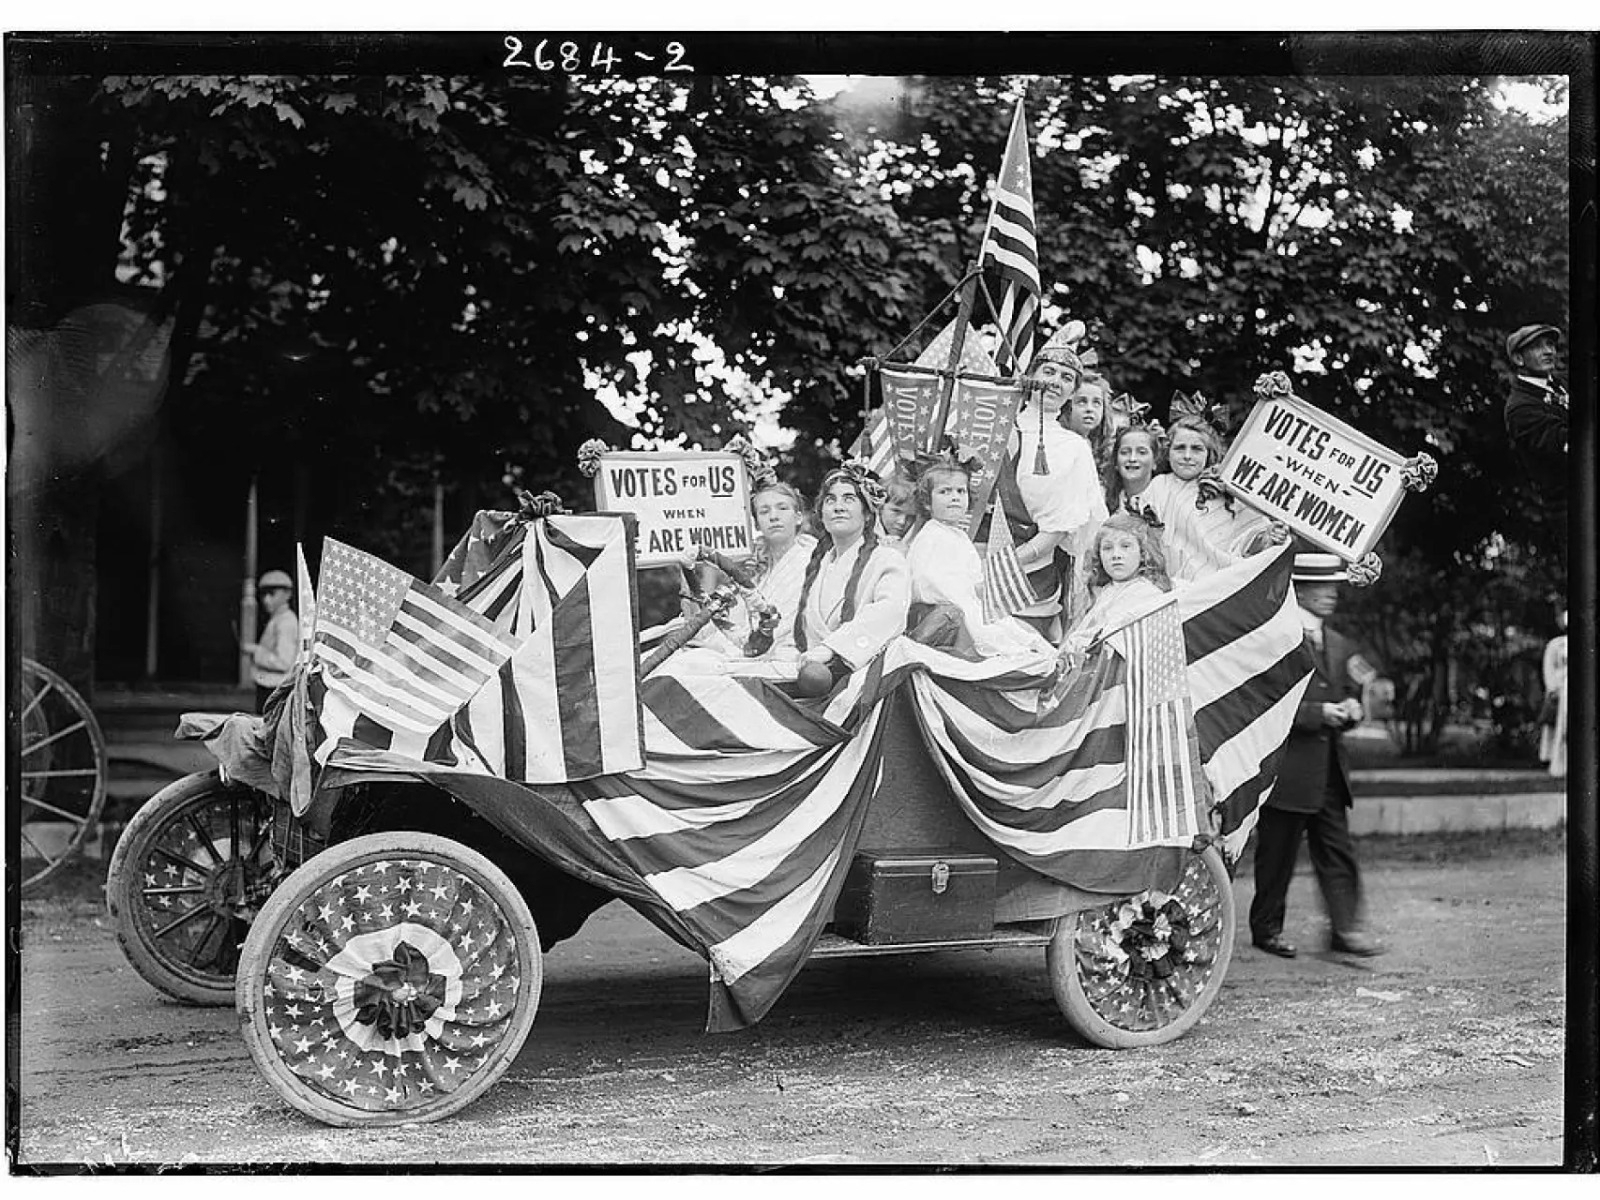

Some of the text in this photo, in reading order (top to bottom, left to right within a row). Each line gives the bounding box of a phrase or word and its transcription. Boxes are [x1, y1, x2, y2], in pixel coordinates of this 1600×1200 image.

[895, 387, 918, 443] VOTES
[970, 395, 998, 454] VOTES
[1264, 405, 1391, 493] VOTES FOR US
[610, 466, 735, 498] VOTES FOR US
[1231, 454, 1366, 548] WE ARE WOMEN
[649, 528, 685, 553] ARE
[689, 525, 747, 549] WOMEN
[663, 508, 706, 519] WHEN
